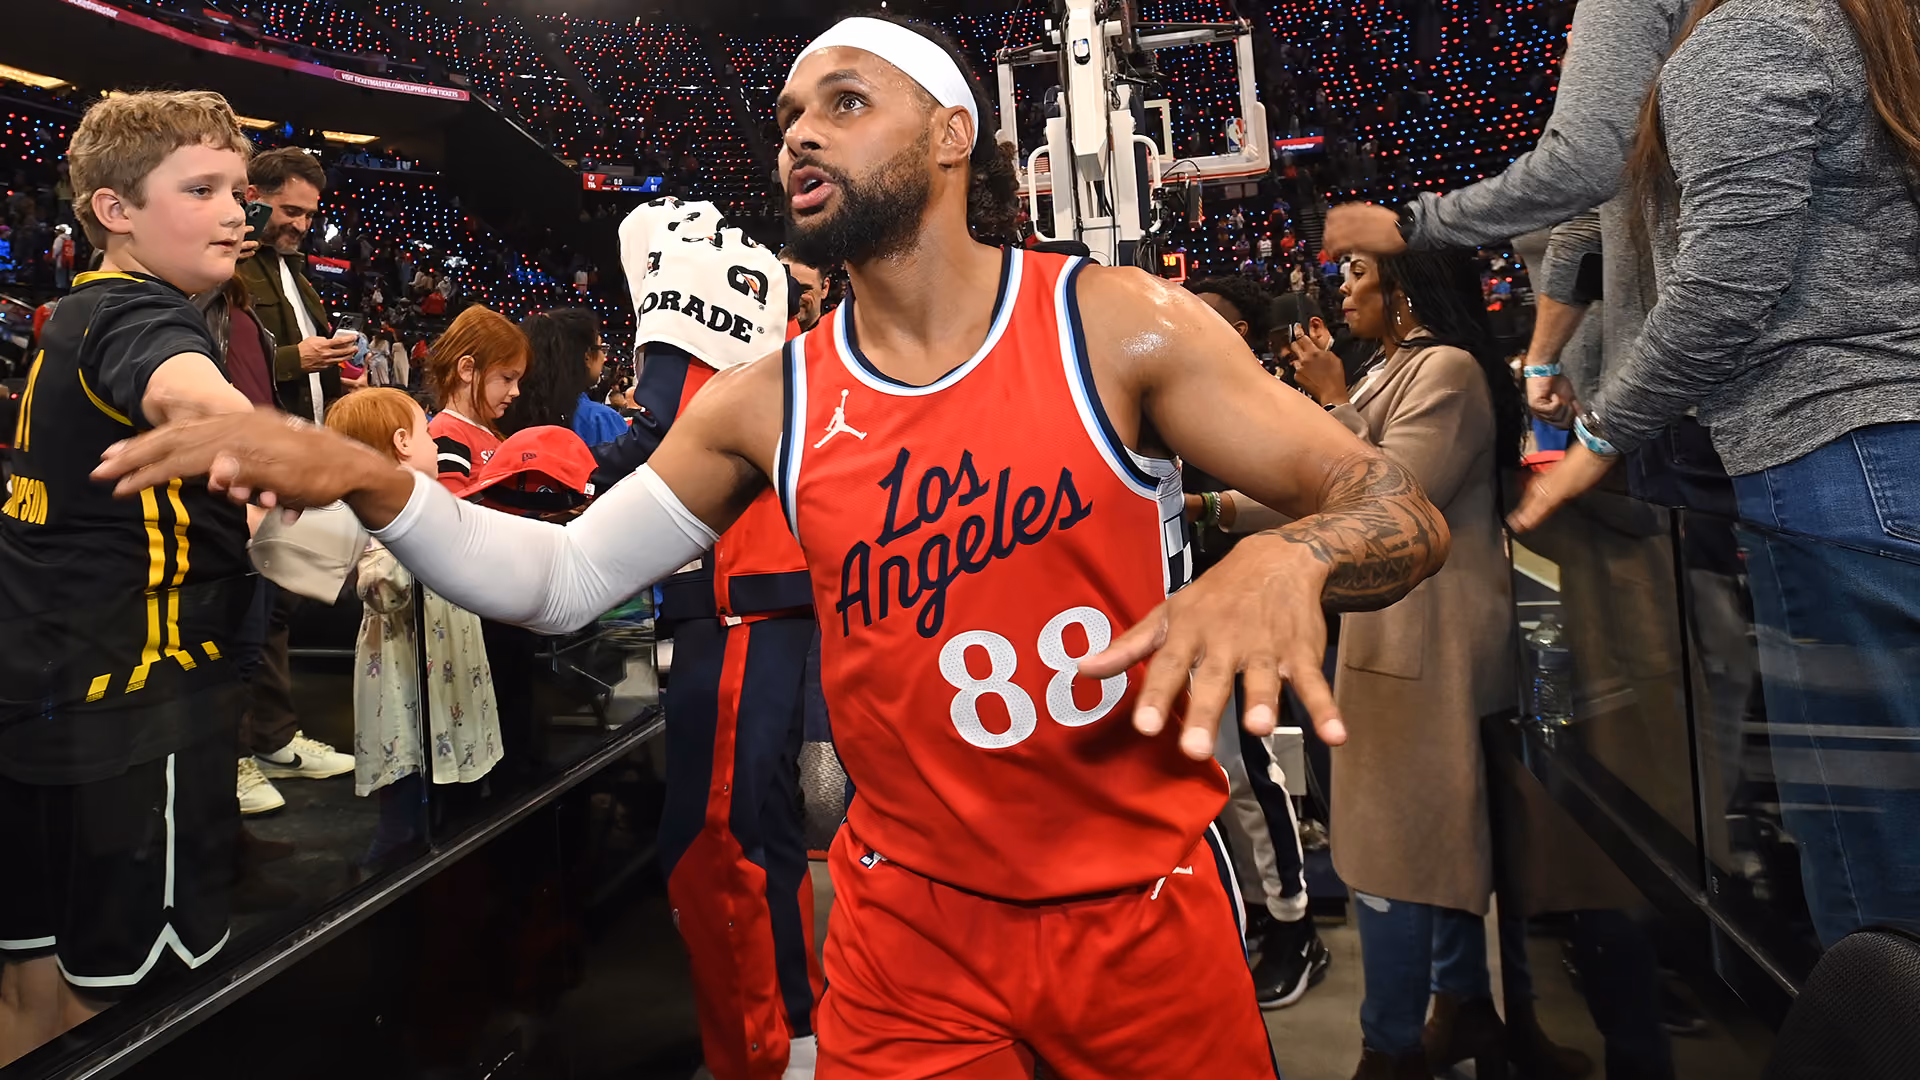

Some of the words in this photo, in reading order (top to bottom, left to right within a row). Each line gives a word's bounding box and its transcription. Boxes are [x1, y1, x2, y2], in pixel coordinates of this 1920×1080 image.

[341, 73, 354, 81] VISIT
[438, 89, 458, 98] TICKETS
[835, 465, 1094, 639] Angeles
[875, 446, 990, 548] Los
[938, 606, 1129, 749] 88
